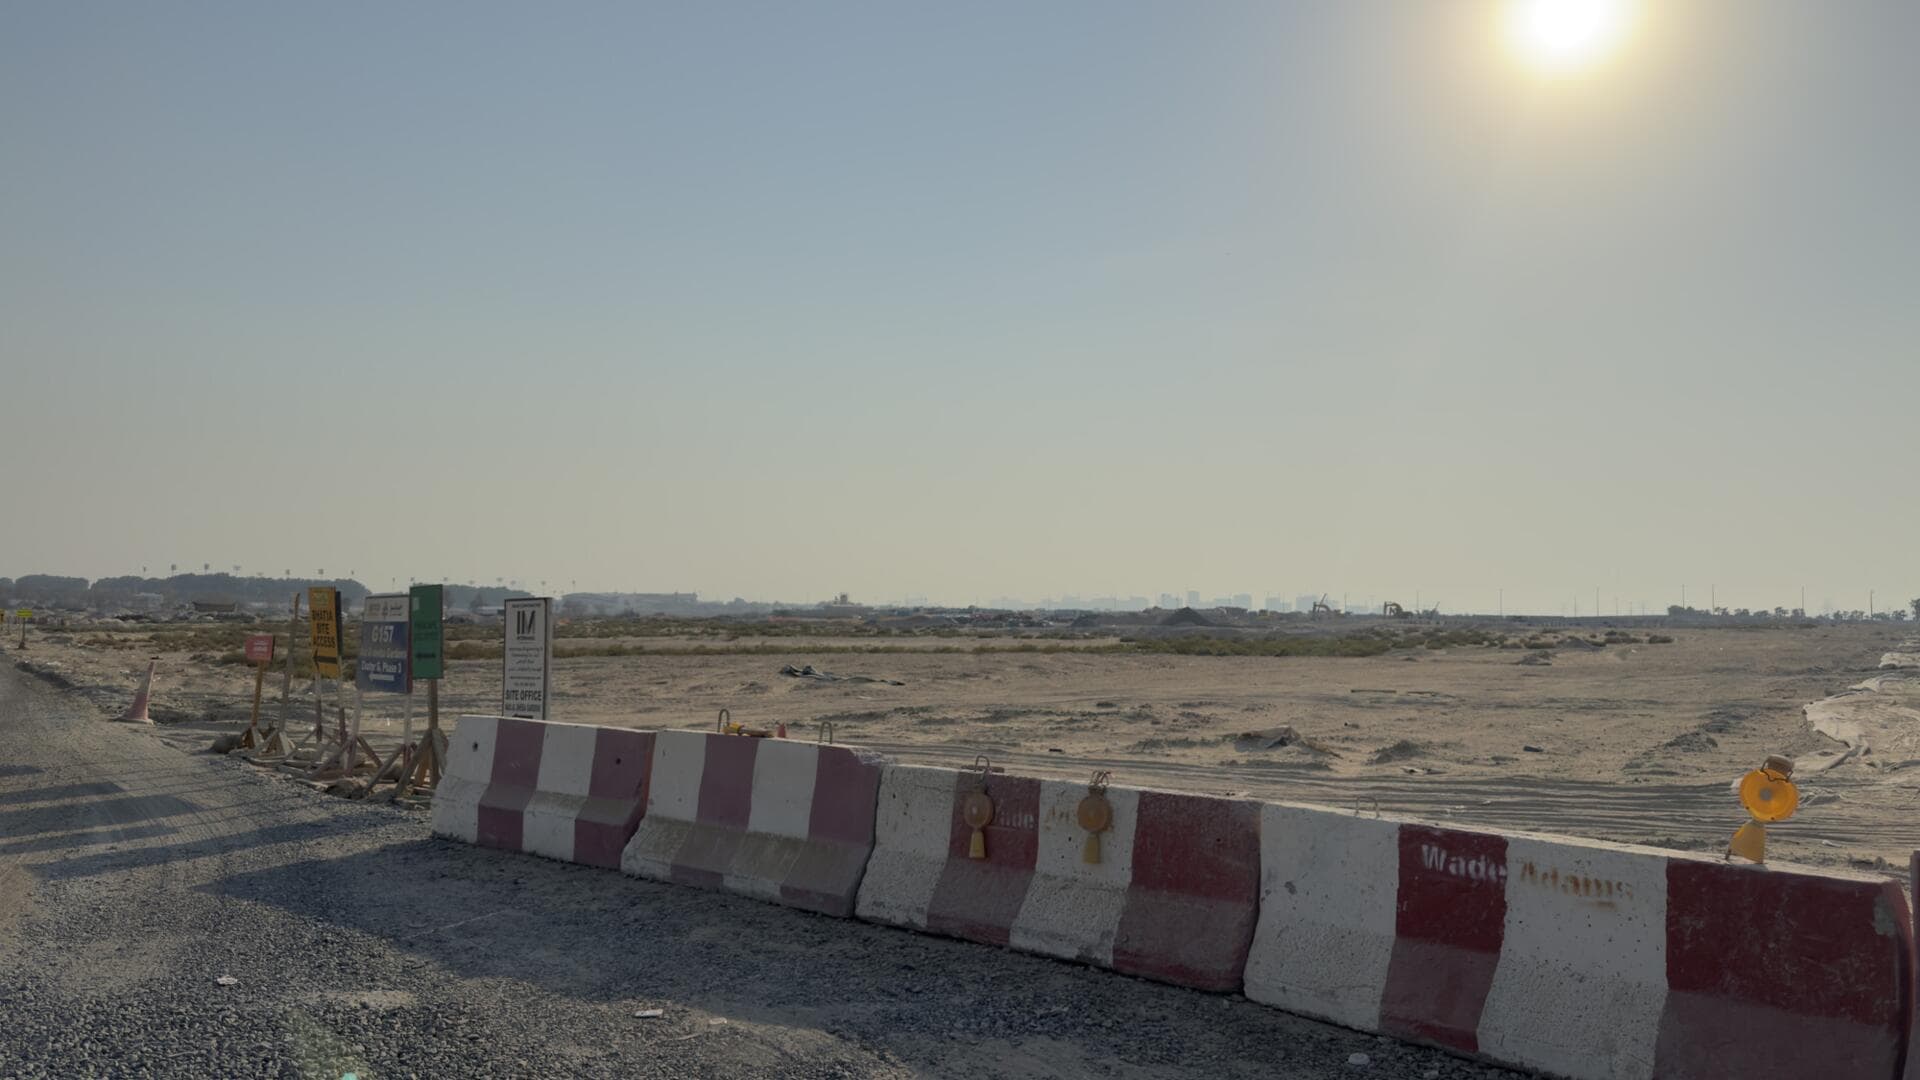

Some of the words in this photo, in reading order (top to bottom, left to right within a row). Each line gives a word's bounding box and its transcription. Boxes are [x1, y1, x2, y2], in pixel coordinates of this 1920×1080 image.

[317, 623, 330, 635] SITE
[313, 635, 336, 649] ACCESS
[506, 689, 519, 700] SITE
[520, 690, 542, 702] OFFICE
[1420, 843, 1507, 883] Wade
[1520, 860, 1634, 899] Adams
